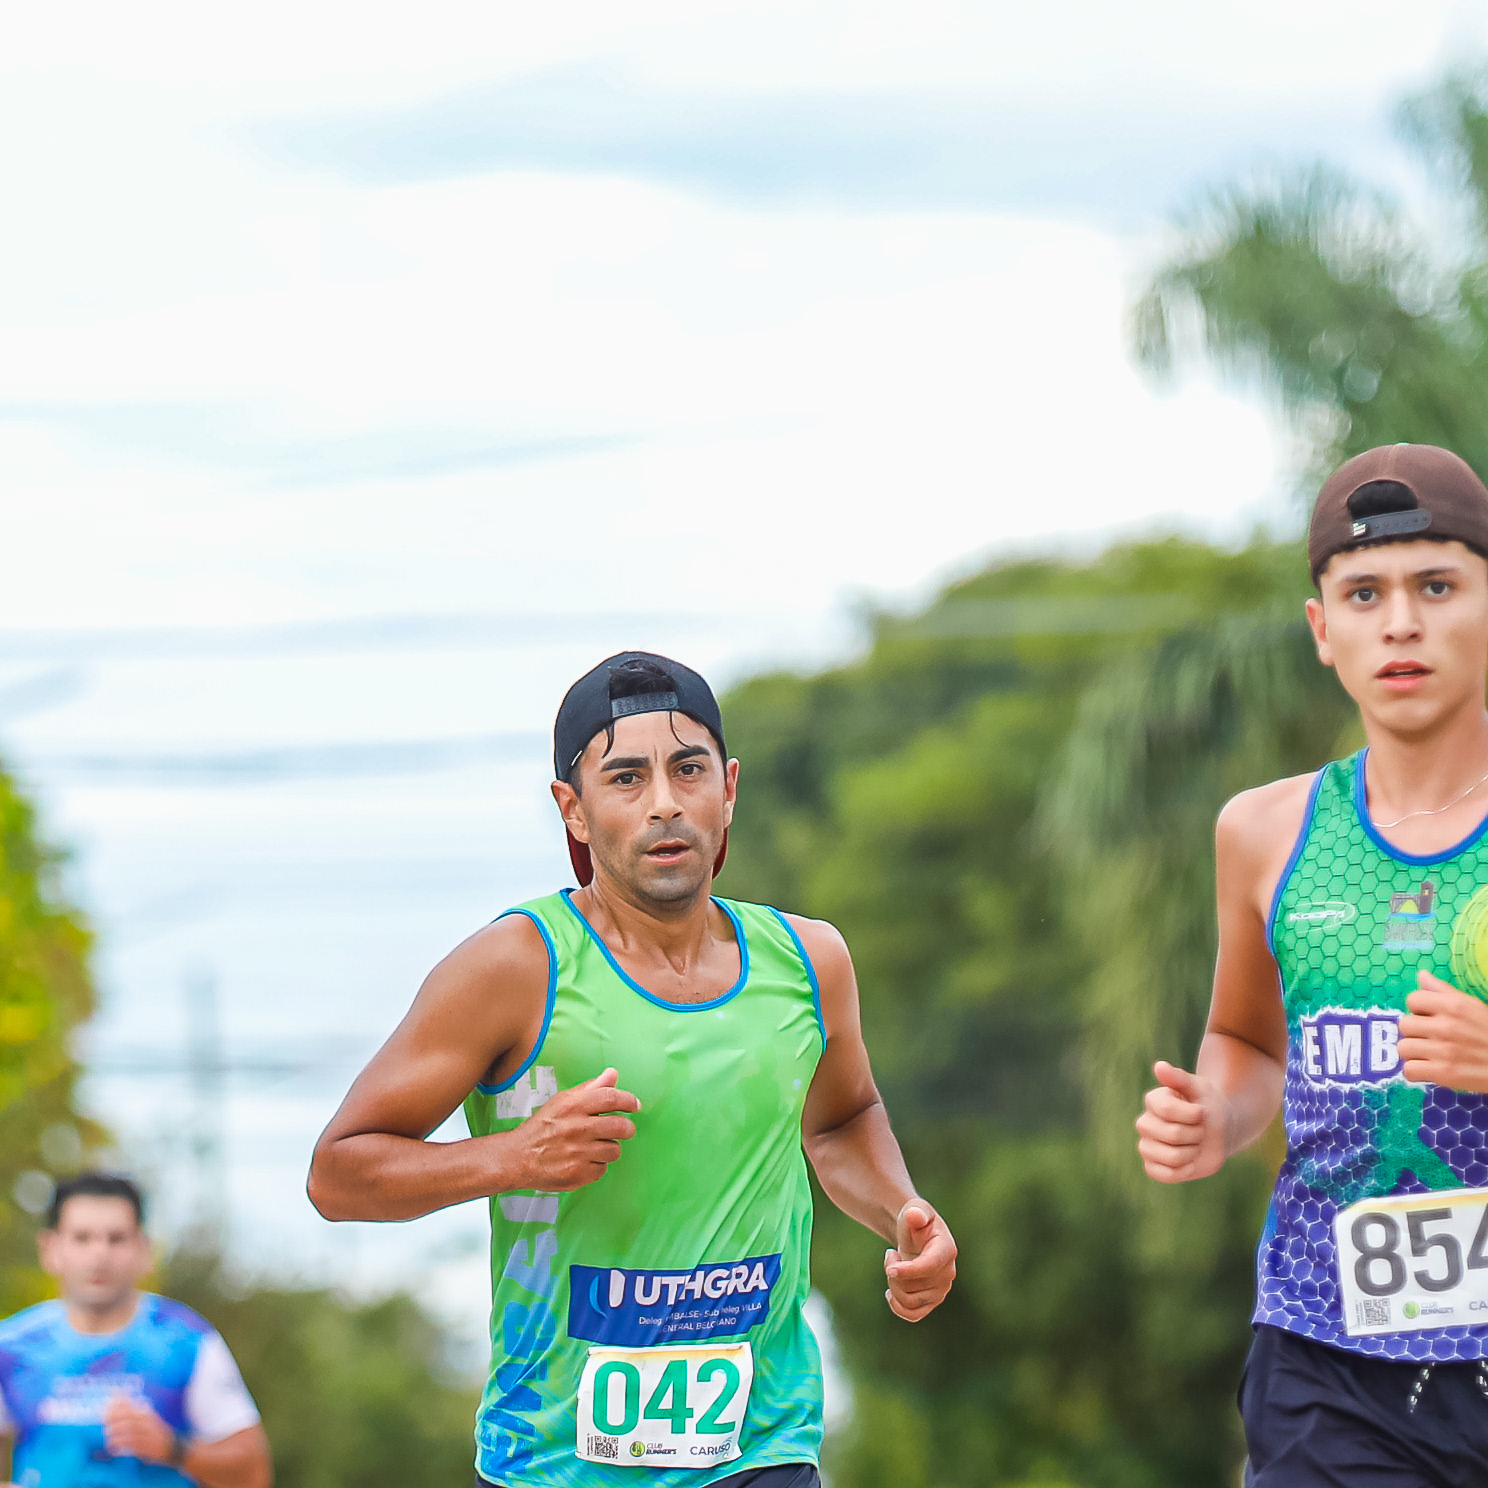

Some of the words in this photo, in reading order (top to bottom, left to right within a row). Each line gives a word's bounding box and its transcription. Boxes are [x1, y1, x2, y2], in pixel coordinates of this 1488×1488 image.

[481, 1065, 558, 1479] EMBALE
[634, 1261, 769, 1306] UTHGRA
[720, 1305, 740, 1315] eleg
[592, 1358, 740, 1436] 042
[689, 1442, 731, 1456] CARUSO
